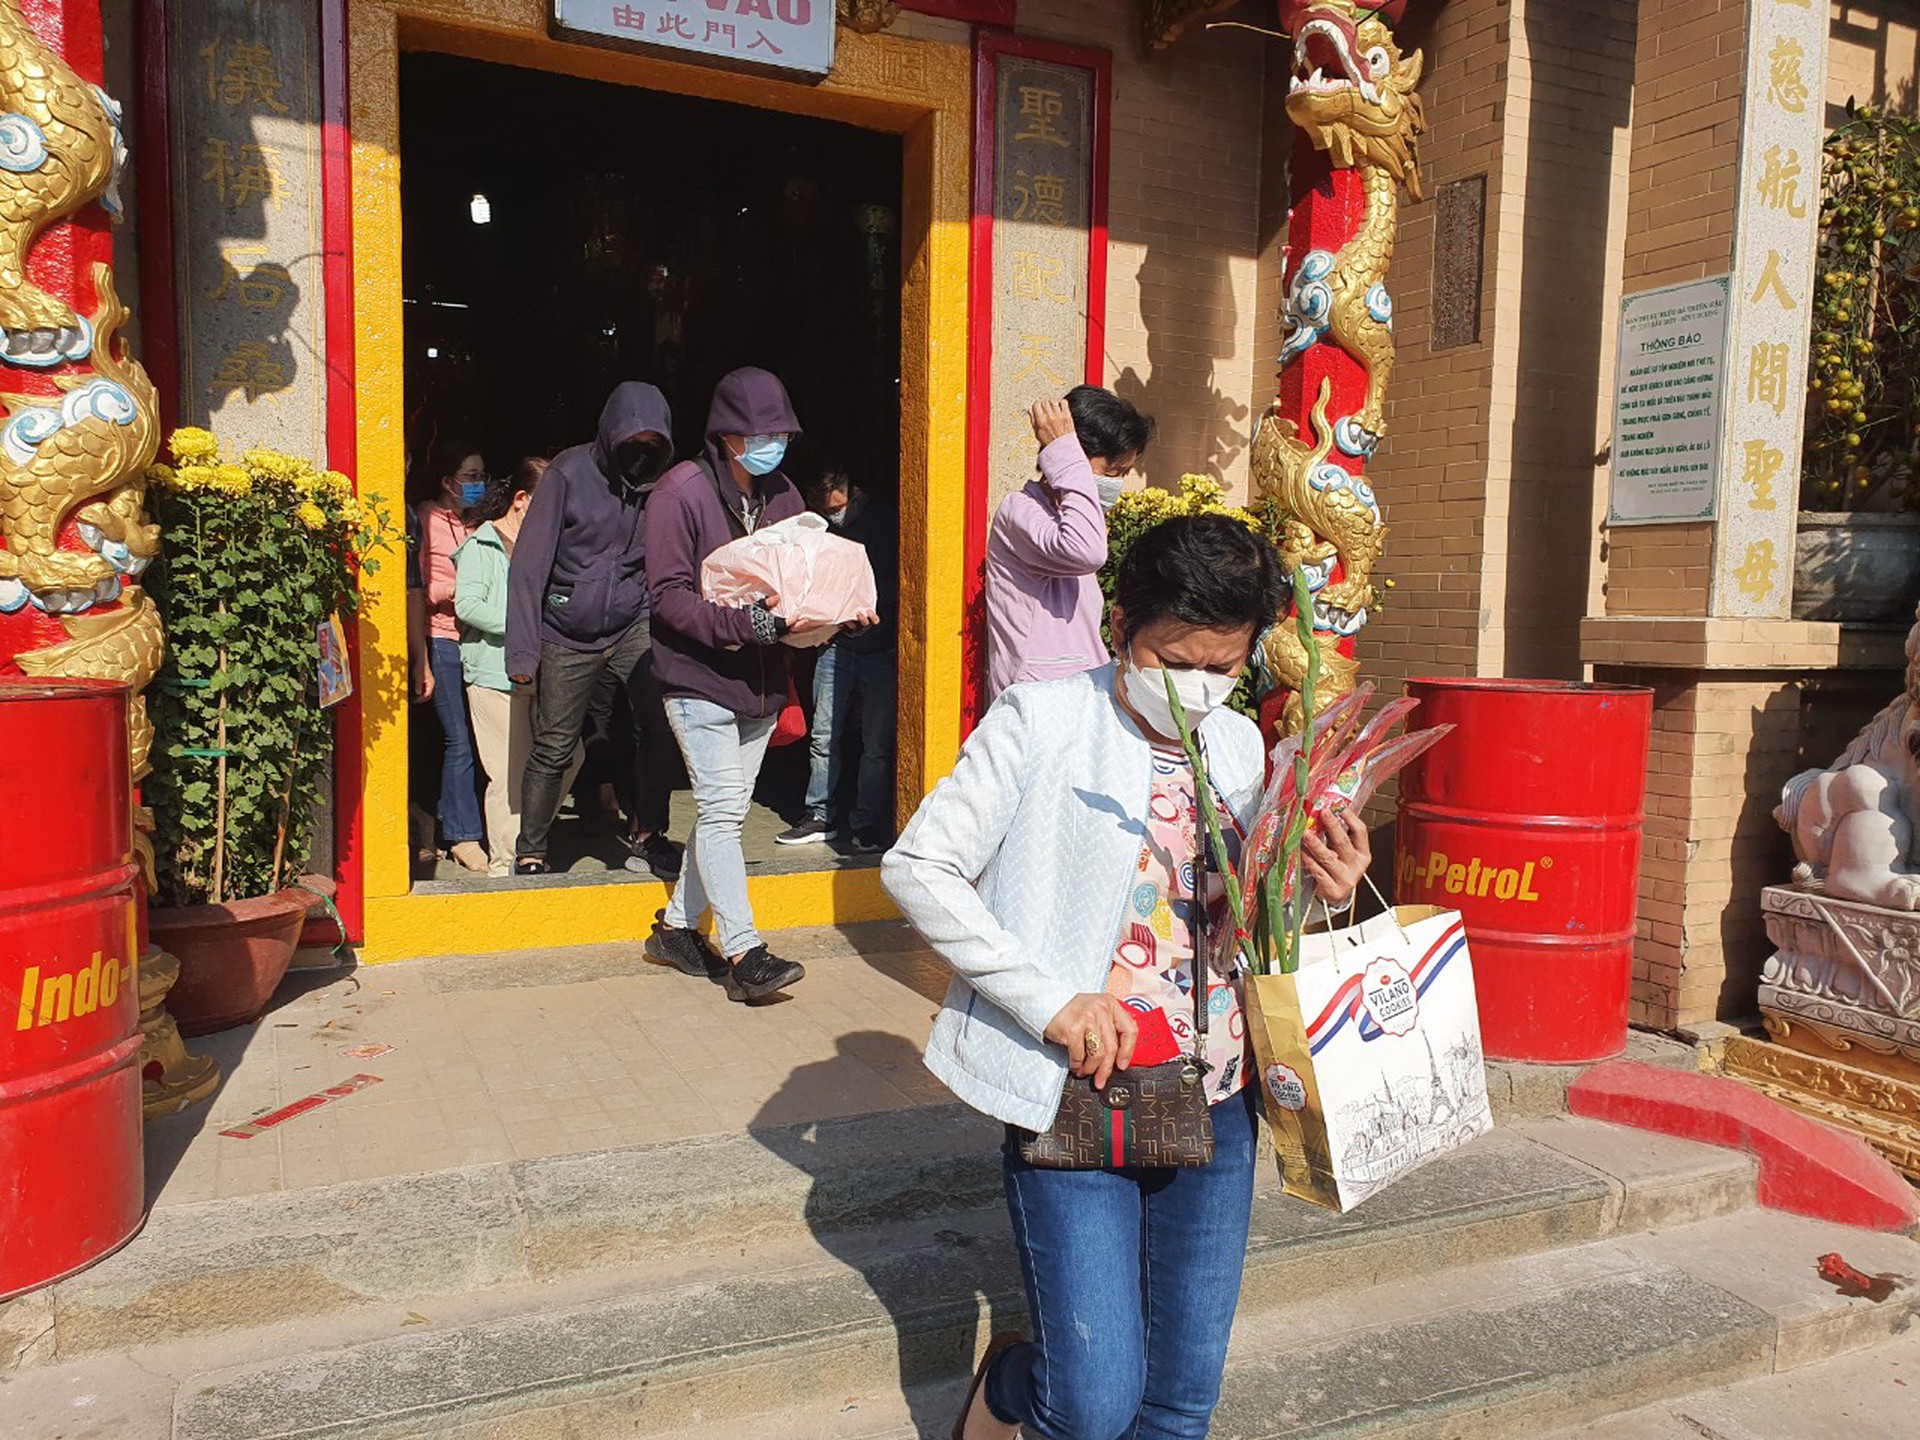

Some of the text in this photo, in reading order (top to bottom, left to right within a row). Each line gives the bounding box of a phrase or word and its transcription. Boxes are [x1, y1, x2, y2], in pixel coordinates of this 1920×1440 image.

[612, 3, 784, 55] 由此門入
[1641, 336, 1676, 352] THÔNG
[1369, 981, 1410, 1007] VILANO
[1379, 995, 1412, 1018] COOKIES
